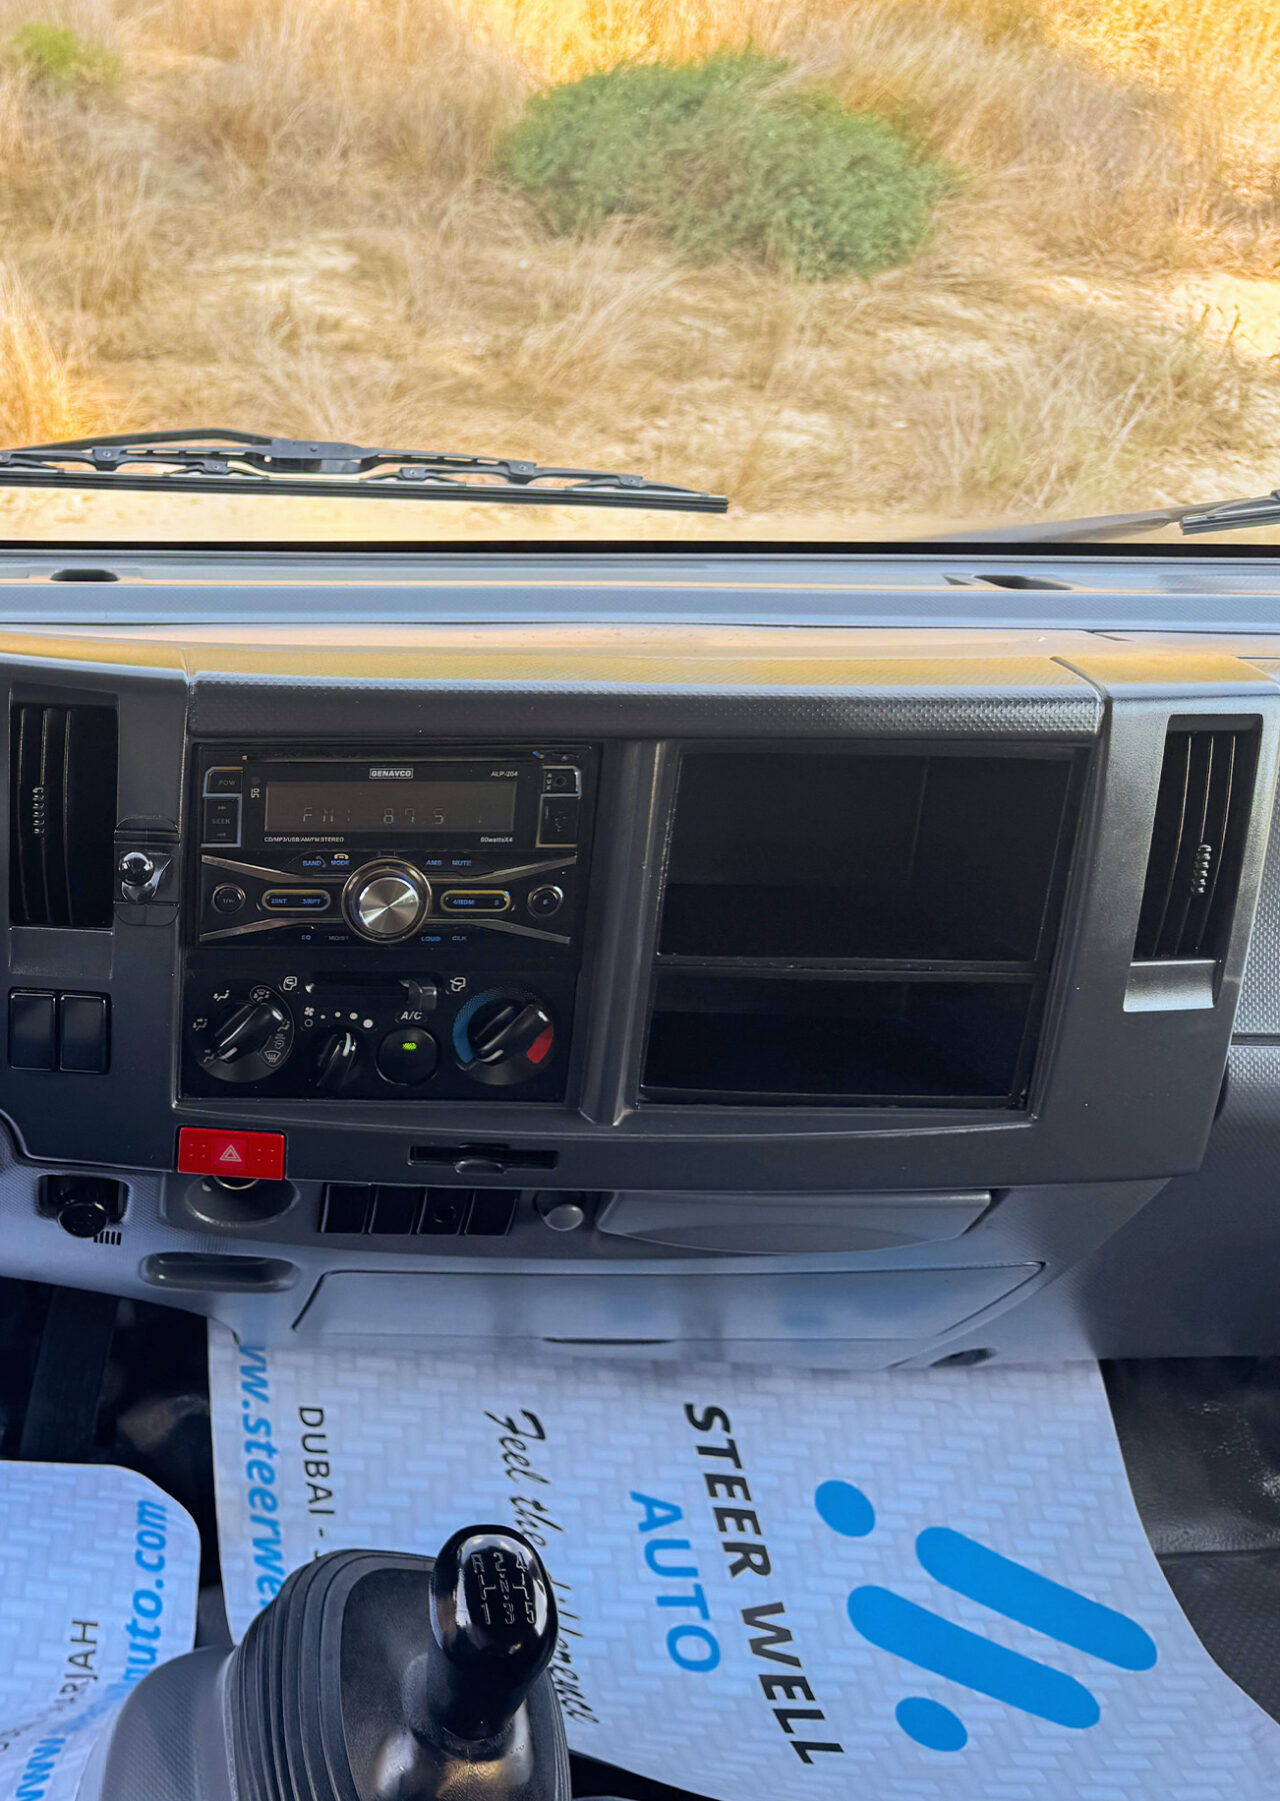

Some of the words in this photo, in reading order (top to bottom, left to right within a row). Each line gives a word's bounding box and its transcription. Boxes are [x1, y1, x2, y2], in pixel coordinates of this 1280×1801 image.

[400, 1011, 423, 1020] A/C
[299, 1406, 336, 1515] DUBAI
[484, 1408, 551, 1485] Feel
[493, 1551, 507, 1572] 2
[515, 1551, 529, 1572] 4
[630, 1490, 721, 1673] AUTO
[684, 1403, 772, 1578] STEER
[740, 1601, 845, 1765] WELL
[525, 1601, 536, 1624] 5
